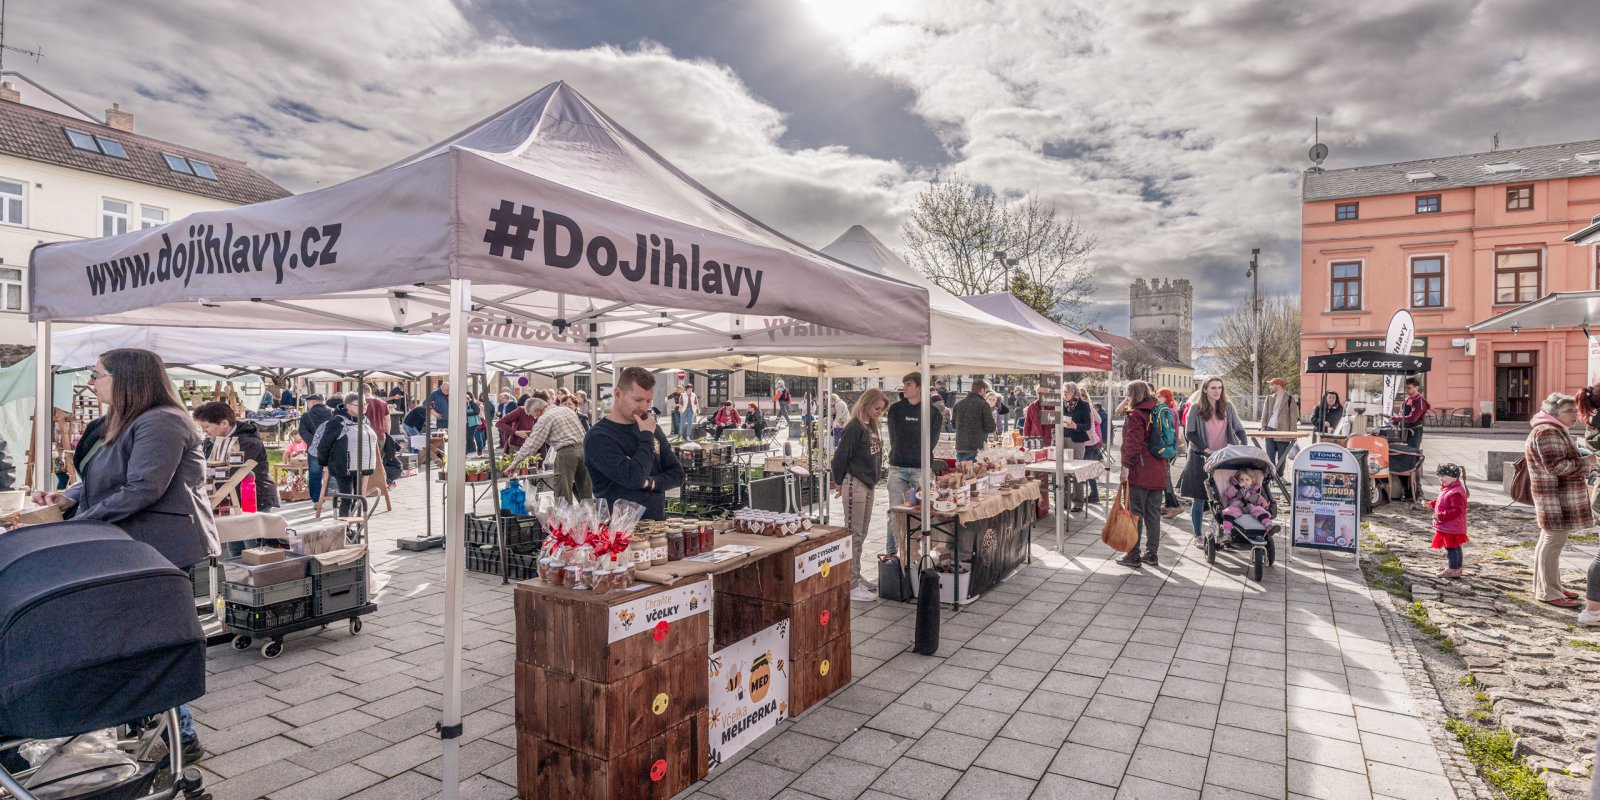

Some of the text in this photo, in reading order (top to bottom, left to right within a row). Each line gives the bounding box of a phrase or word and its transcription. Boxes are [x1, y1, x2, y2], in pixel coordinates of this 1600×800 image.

[86, 222, 343, 296] www.dojihlavy.cz
[483, 199, 763, 309] #DoJihlavy
[1372, 360, 1403, 368] COFFEE
[645, 594, 672, 610] Chraňte
[751, 674, 769, 693] MED
[721, 705, 748, 728] Včelka
